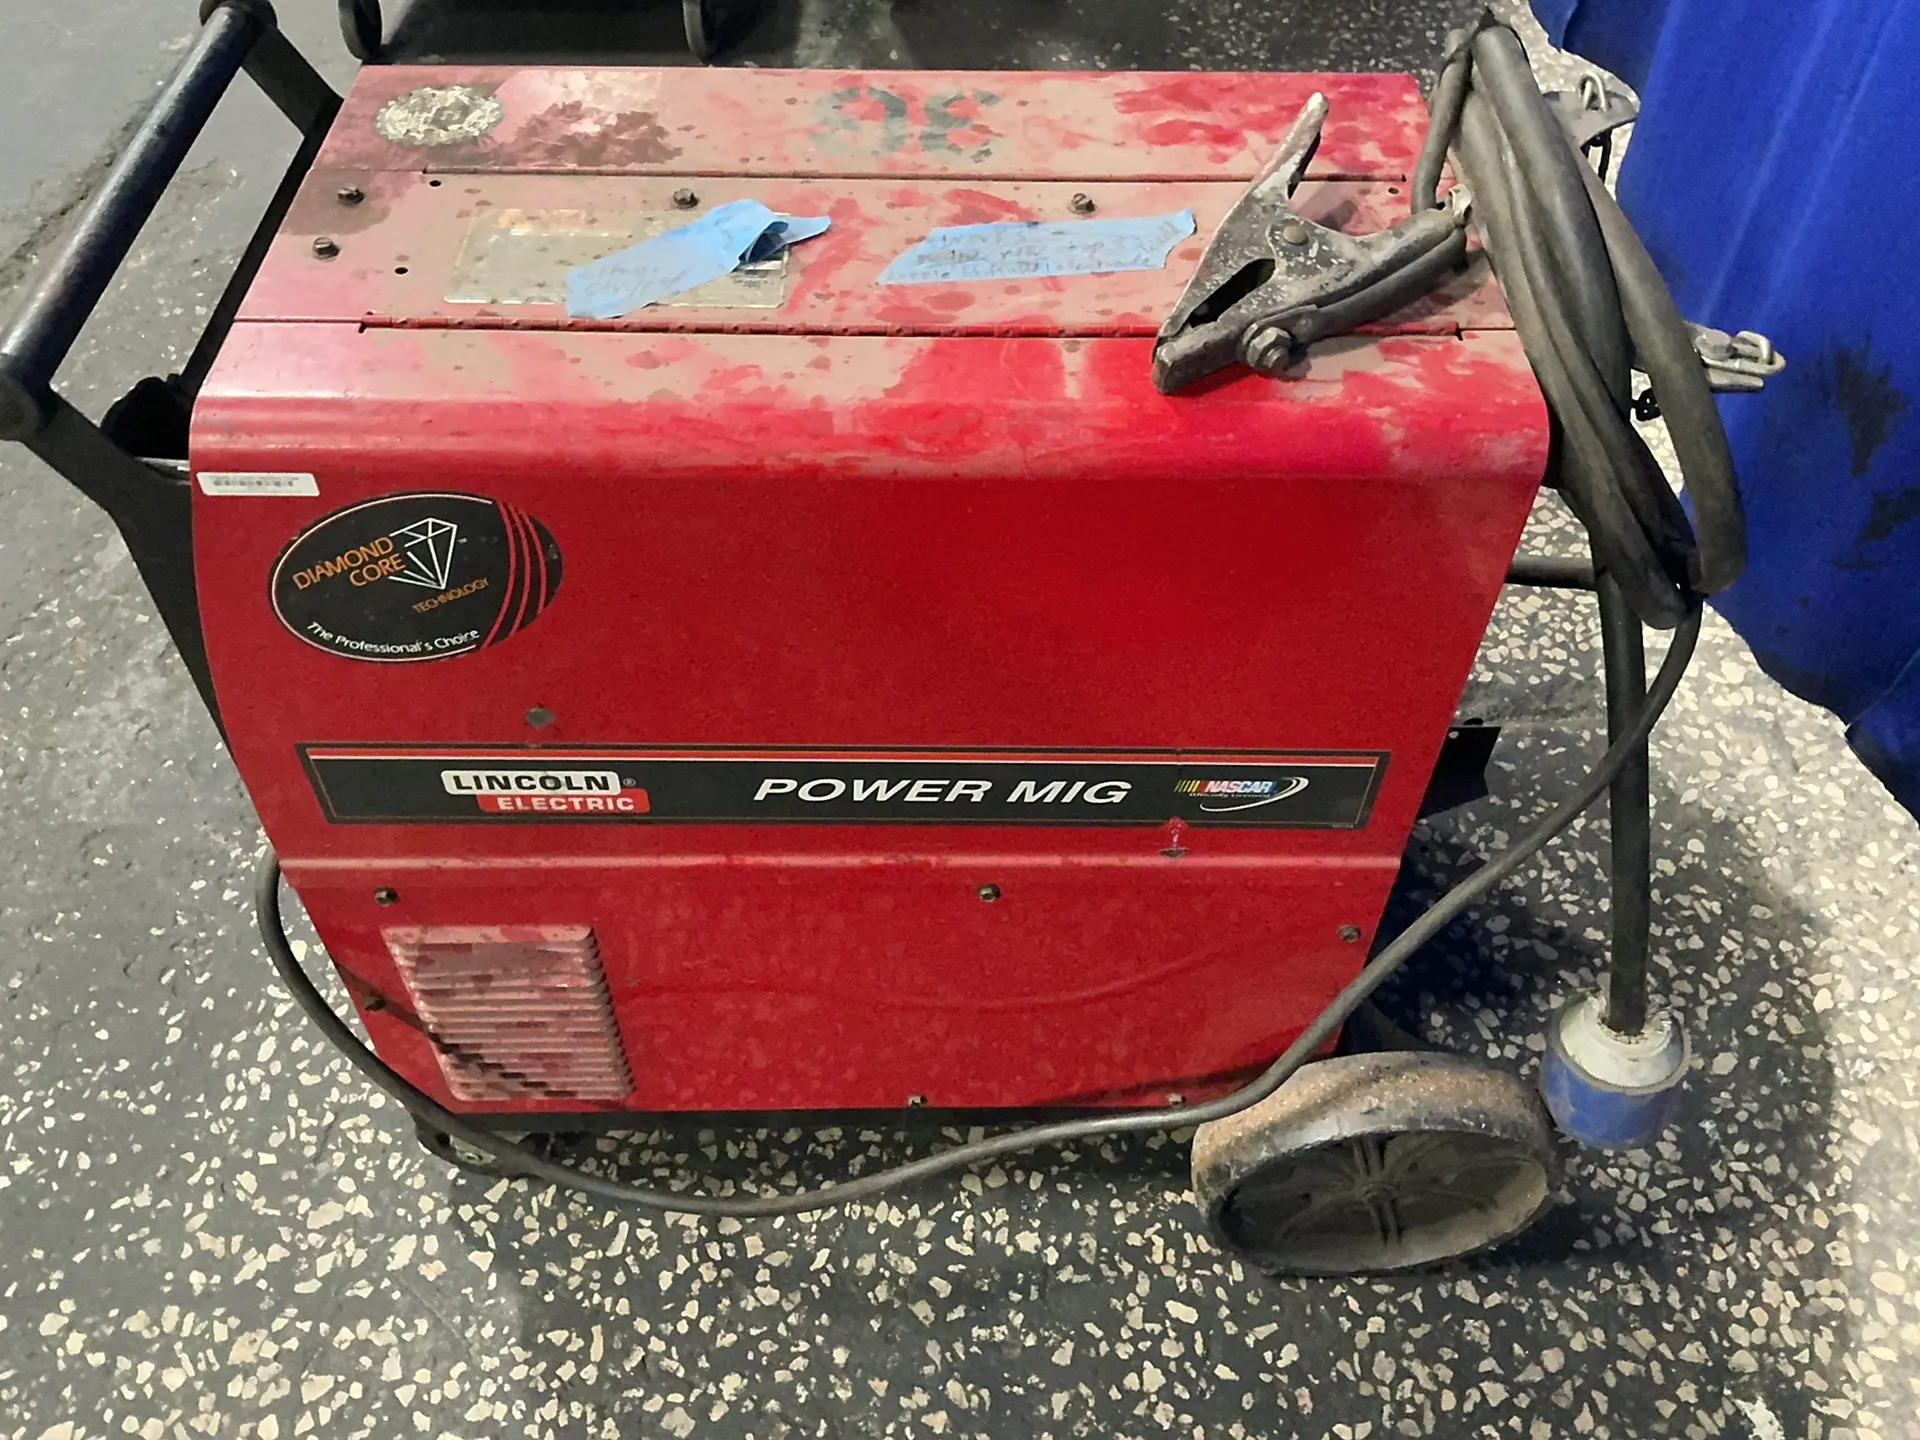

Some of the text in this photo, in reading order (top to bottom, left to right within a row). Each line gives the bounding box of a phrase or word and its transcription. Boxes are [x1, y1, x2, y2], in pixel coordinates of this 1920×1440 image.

[292, 536, 394, 590] DIAMOND
[349, 552, 407, 587] CORE
[411, 577, 490, 613] TECHNOLOGY
[306, 621, 481, 655] The Professional's Choice
[452, 774, 611, 791] LINCOLN
[753, 778, 1133, 803] POWER MIG
[1203, 780, 1274, 793] NASCAR
[496, 796, 636, 811] ELECTRIC
